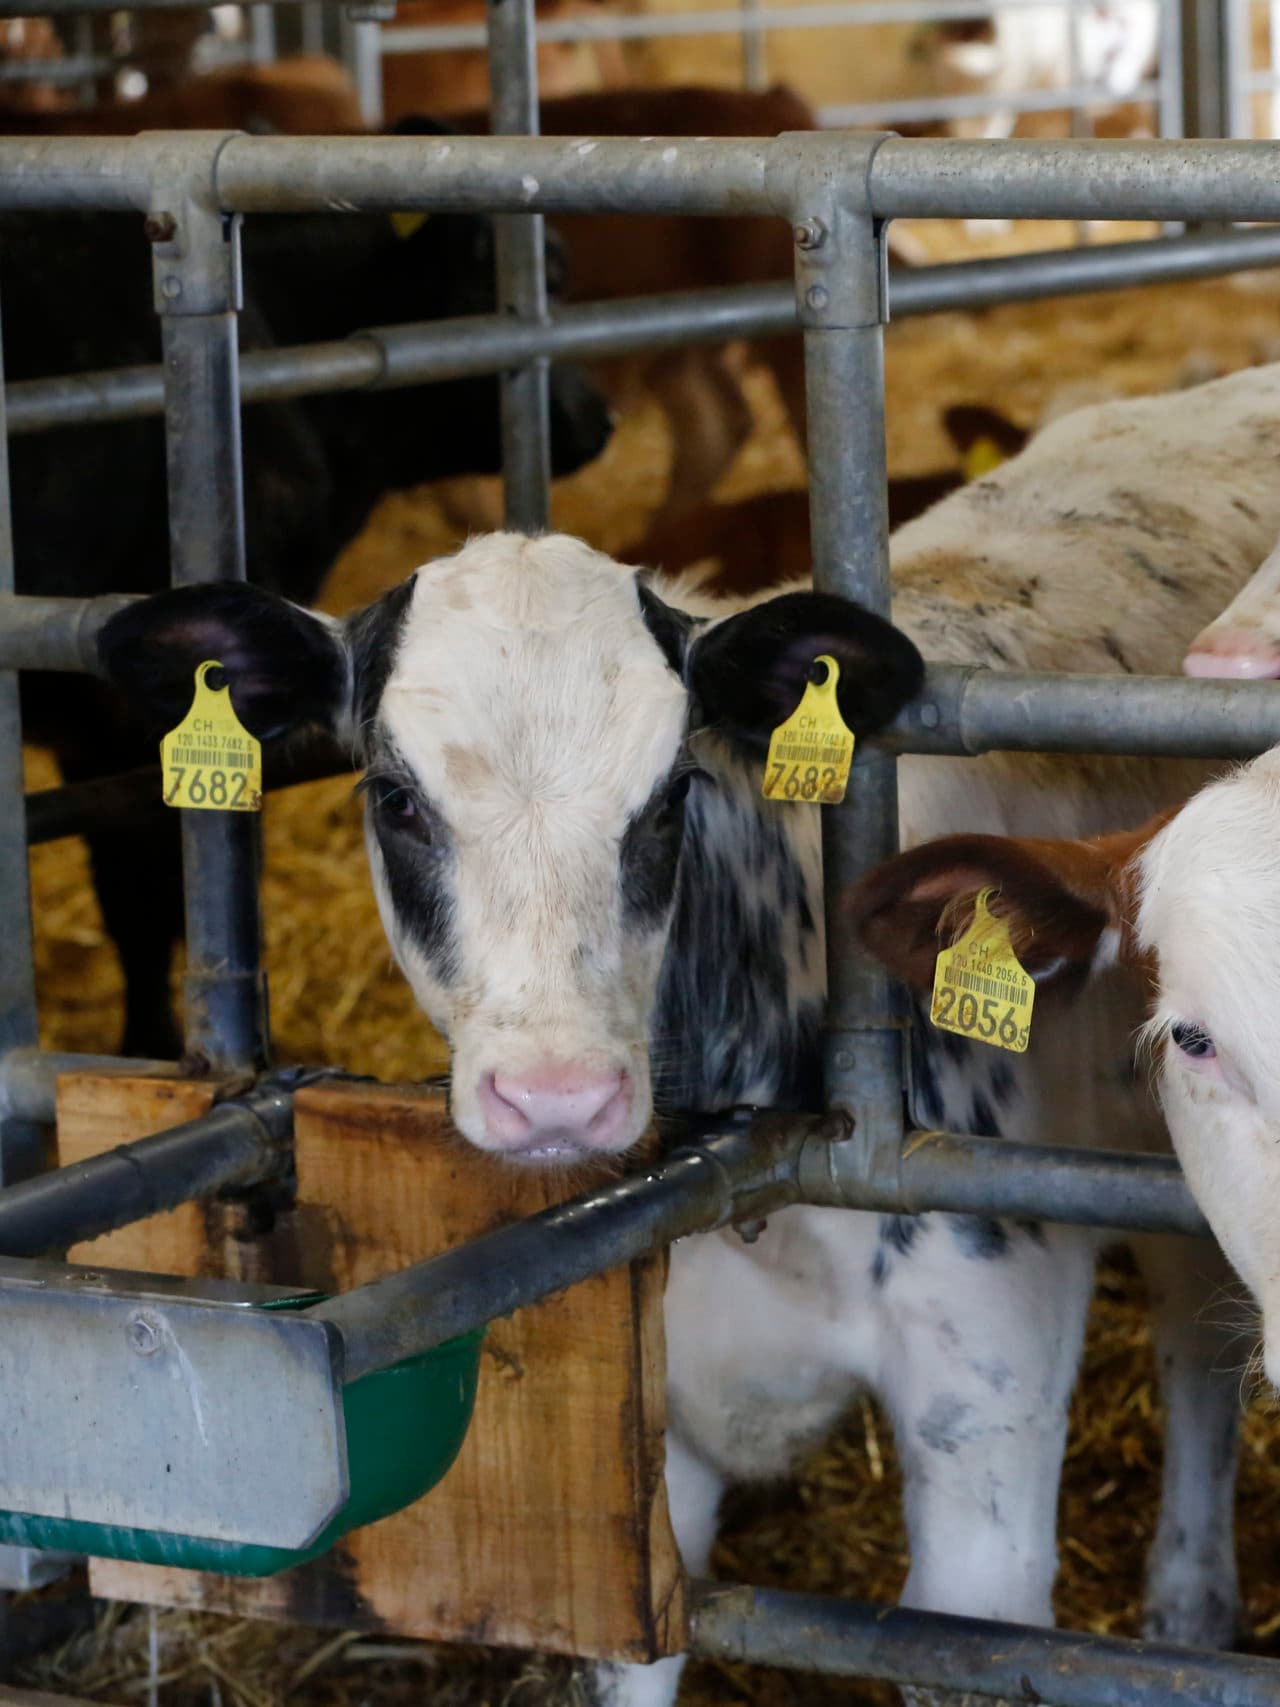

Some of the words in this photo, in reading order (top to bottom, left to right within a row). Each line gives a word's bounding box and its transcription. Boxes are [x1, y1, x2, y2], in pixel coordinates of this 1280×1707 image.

[193, 718, 213, 732] CH
[799, 716, 817, 729] CH
[968, 940, 989, 959] CH
